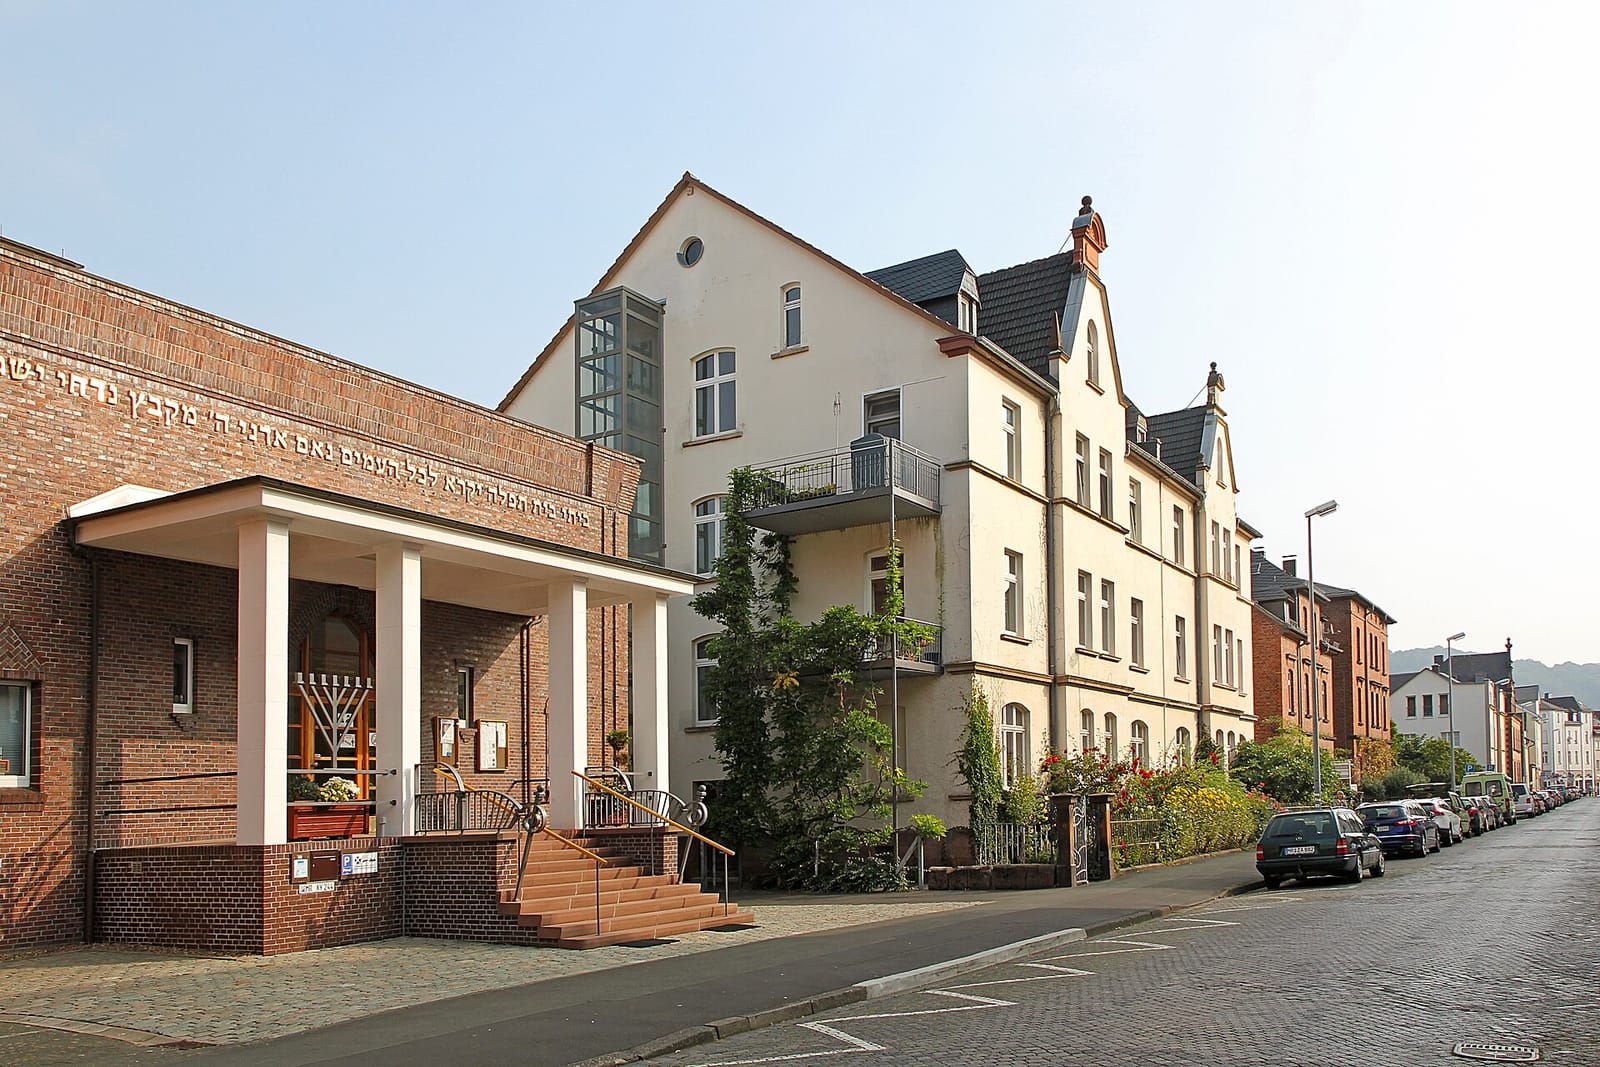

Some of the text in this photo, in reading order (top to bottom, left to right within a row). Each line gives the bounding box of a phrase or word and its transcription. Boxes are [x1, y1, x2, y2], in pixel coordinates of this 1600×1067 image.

[56, 370, 118, 405] נדחי
[128, 389, 197, 426] מקבץ
[238, 419, 287, 449] אדני
[294, 433, 333, 461] נאם
[339, 445, 400, 480] העמים
[404, 454, 438, 487] לכל
[443, 474, 483, 503] יקרא
[486, 484, 528, 512] תפלה
[531, 498, 556, 520] בית
[560, 506, 589, 528] ביתי
[344, 856, 351, 866] P
